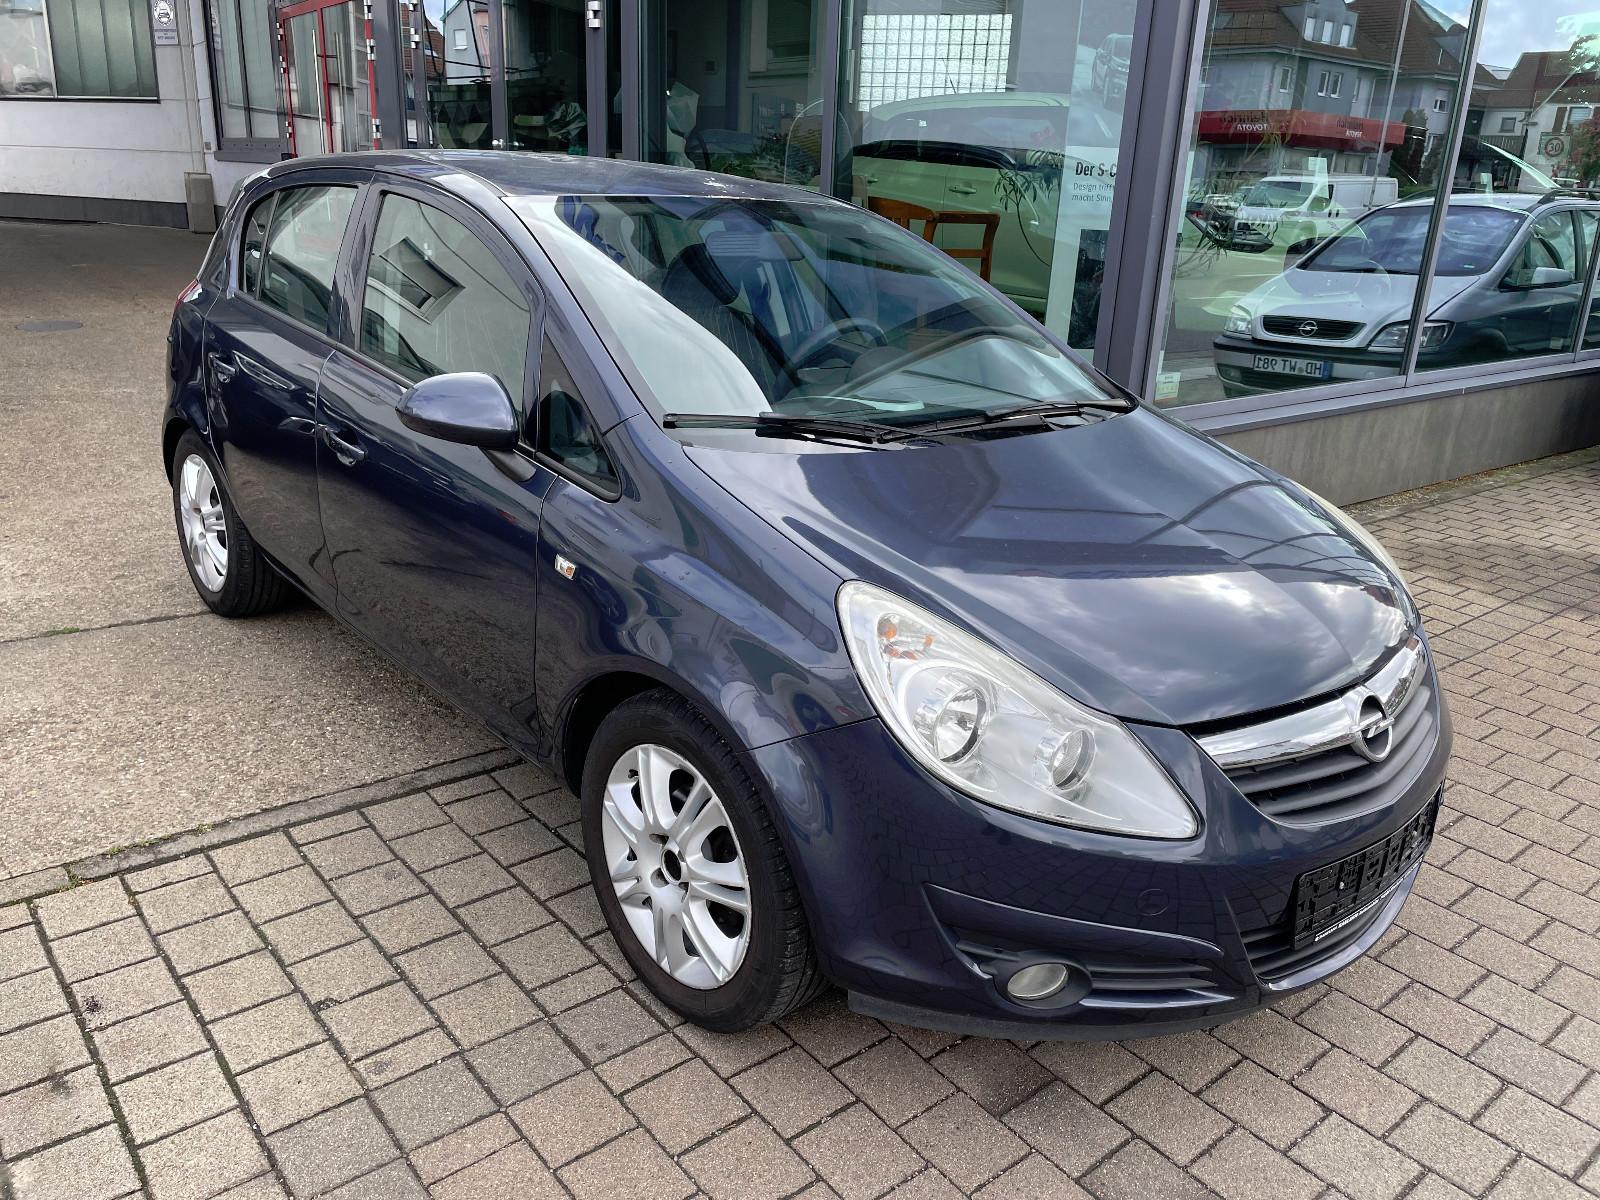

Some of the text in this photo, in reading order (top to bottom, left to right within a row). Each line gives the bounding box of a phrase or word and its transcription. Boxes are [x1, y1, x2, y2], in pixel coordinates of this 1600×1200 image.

[1076, 162, 1095, 176] Der
[1074, 182, 1097, 192] Design
[1071, 193, 1094, 202] macht
